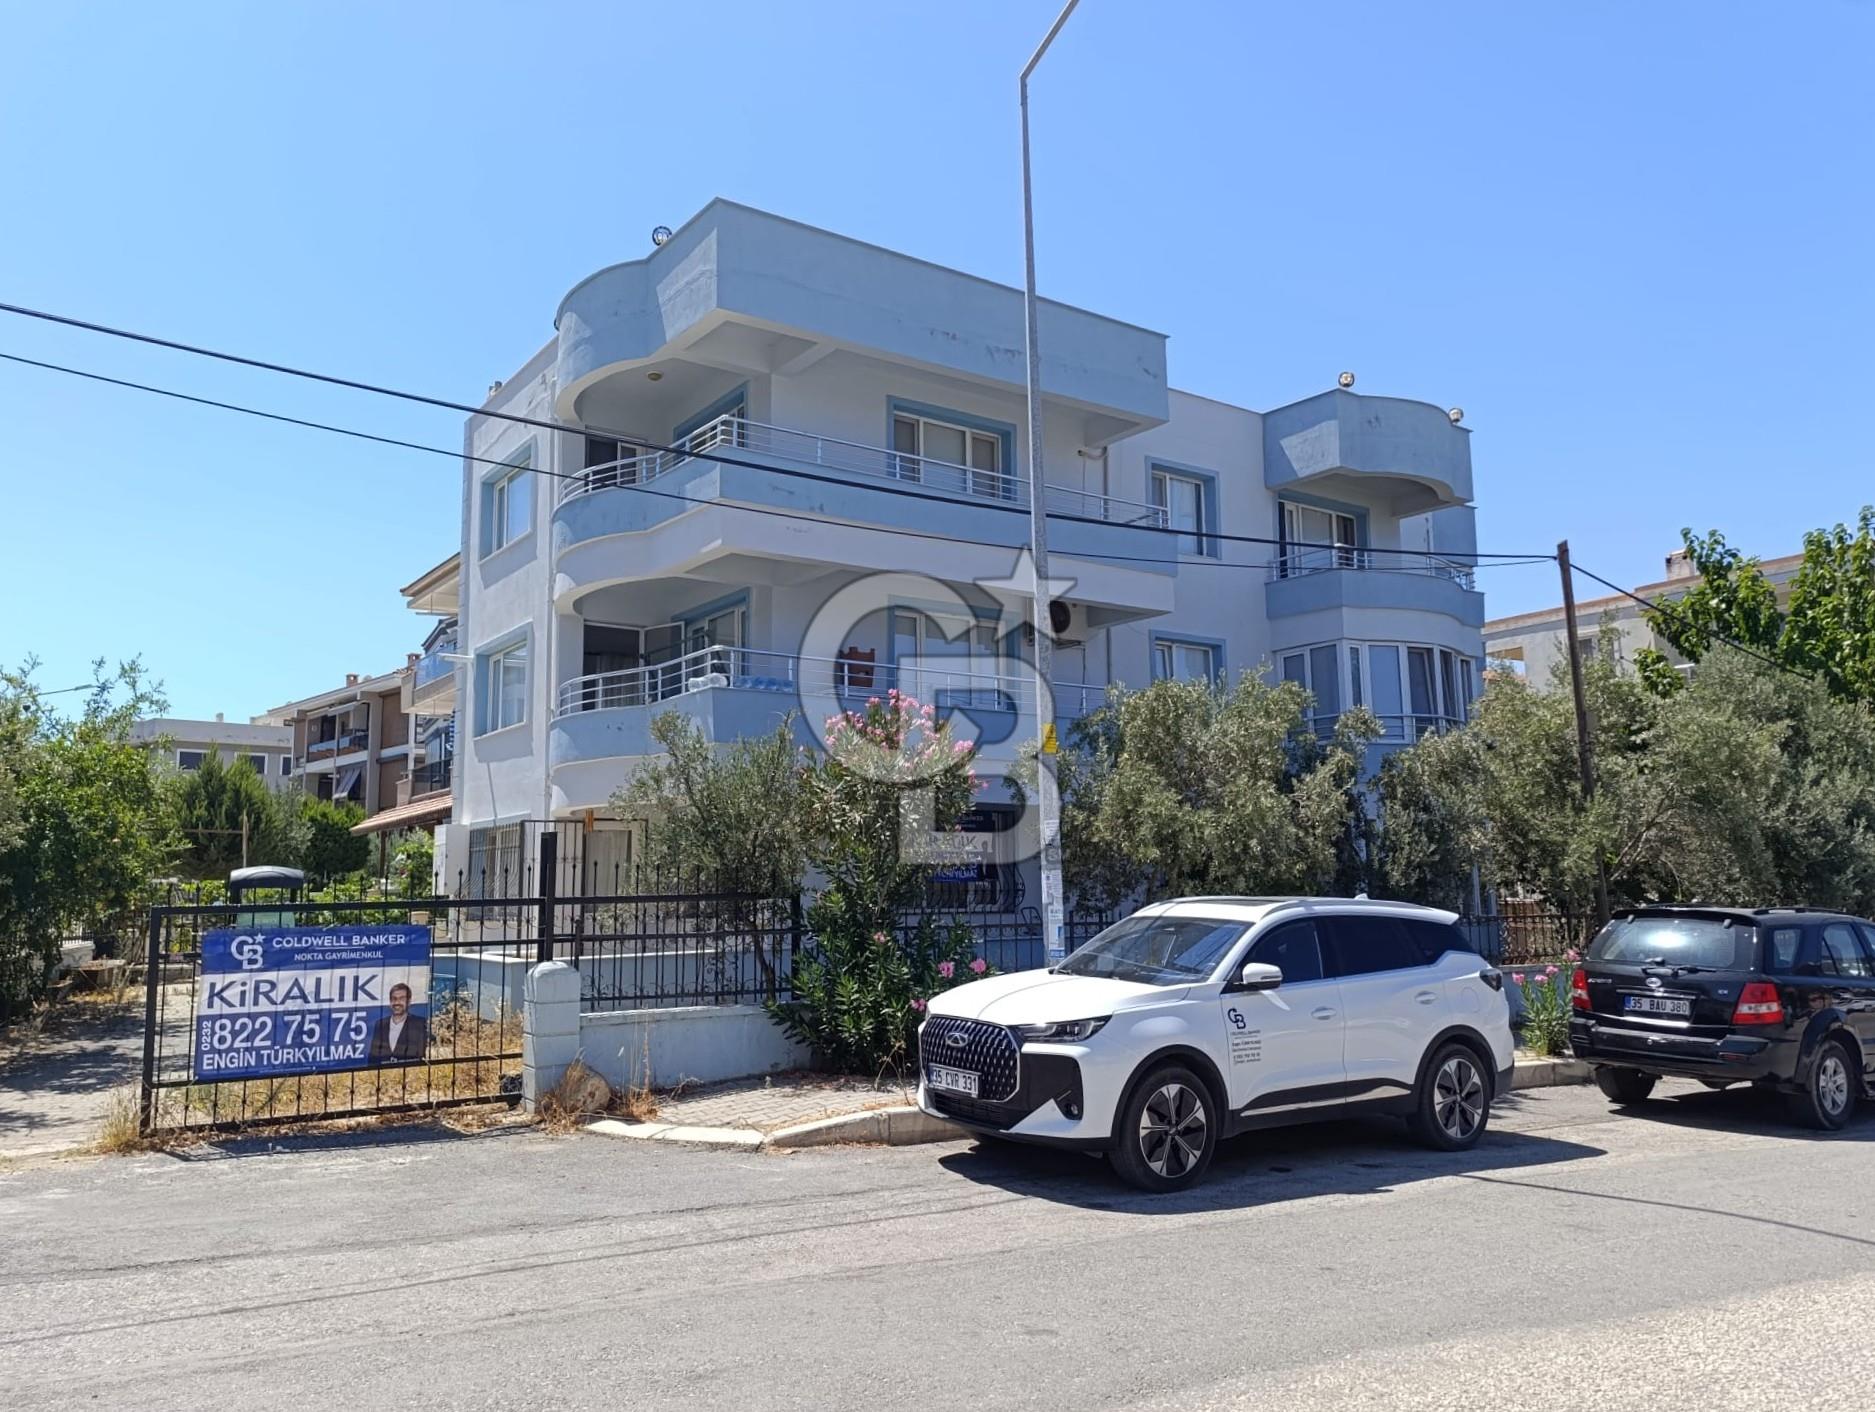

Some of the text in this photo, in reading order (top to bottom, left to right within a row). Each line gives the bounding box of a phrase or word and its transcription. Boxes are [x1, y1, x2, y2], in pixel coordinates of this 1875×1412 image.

[272, 934, 406, 948] COLDWELL BANKER
[294, 951, 384, 961] NOKTA GAYRİMENKUL
[1631, 998, 1643, 1009] 35
[1649, 999, 1667, 1011] BAU
[201, 1020, 212, 1051] 0232
[212, 1011, 368, 1050] 822 75 75
[202, 1043, 365, 1070] ENGİN TÜRKYILMAZ
